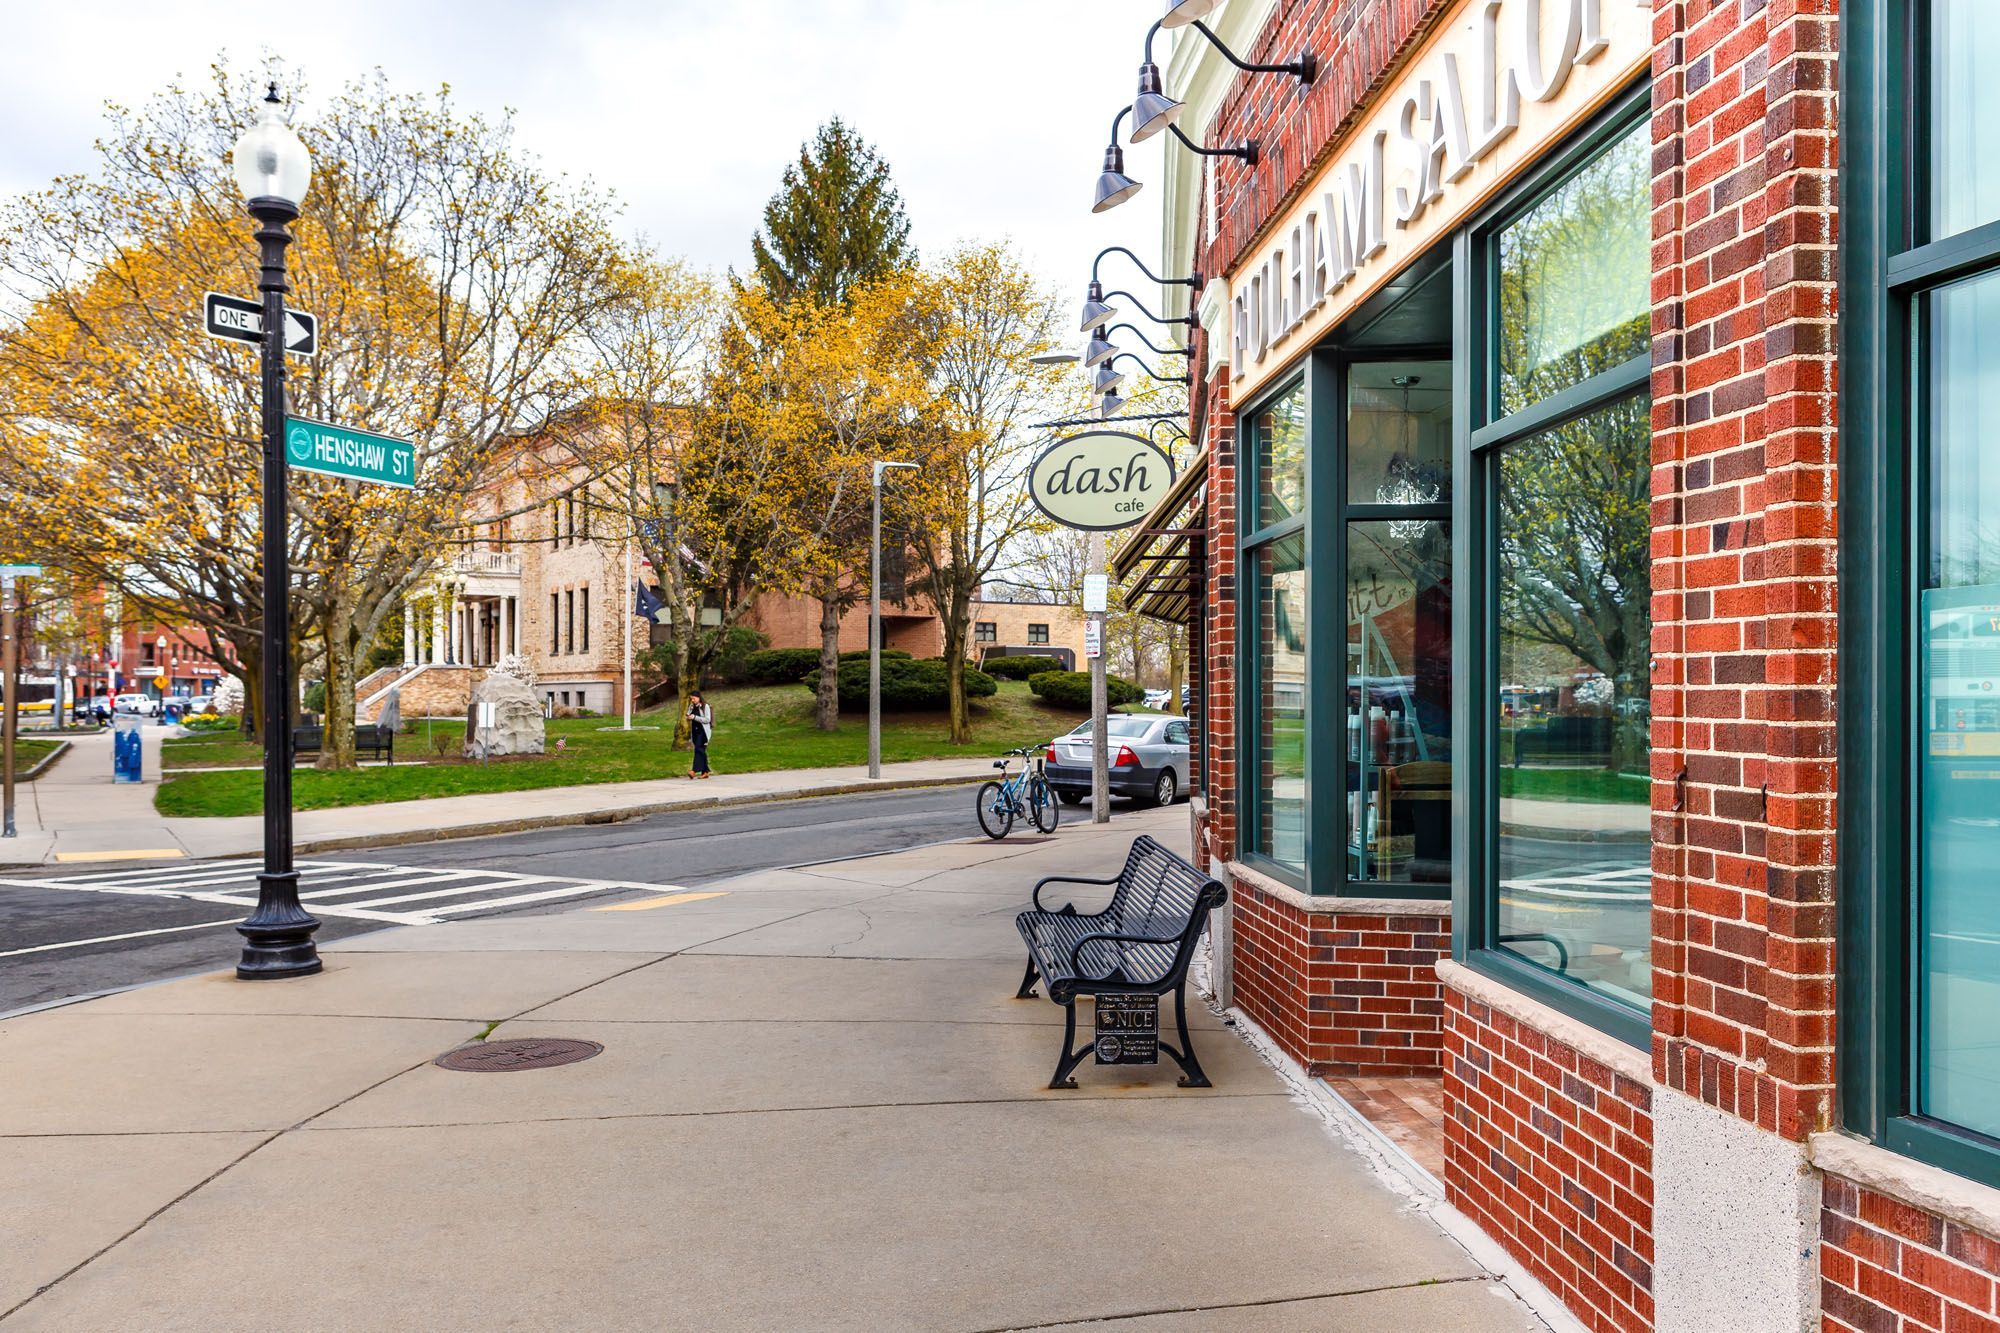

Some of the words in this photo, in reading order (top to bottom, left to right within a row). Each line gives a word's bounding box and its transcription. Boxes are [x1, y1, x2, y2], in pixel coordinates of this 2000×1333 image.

[1231, 130, 1388, 383] FULHAM
[220, 309, 248, 329] ONE
[315, 433, 386, 472] HENSHAW
[392, 448, 410, 476] ST
[1046, 452, 1152, 495] dash
[1114, 498, 1145, 512] cafe
[1116, 1011, 1153, 1028] NICE
